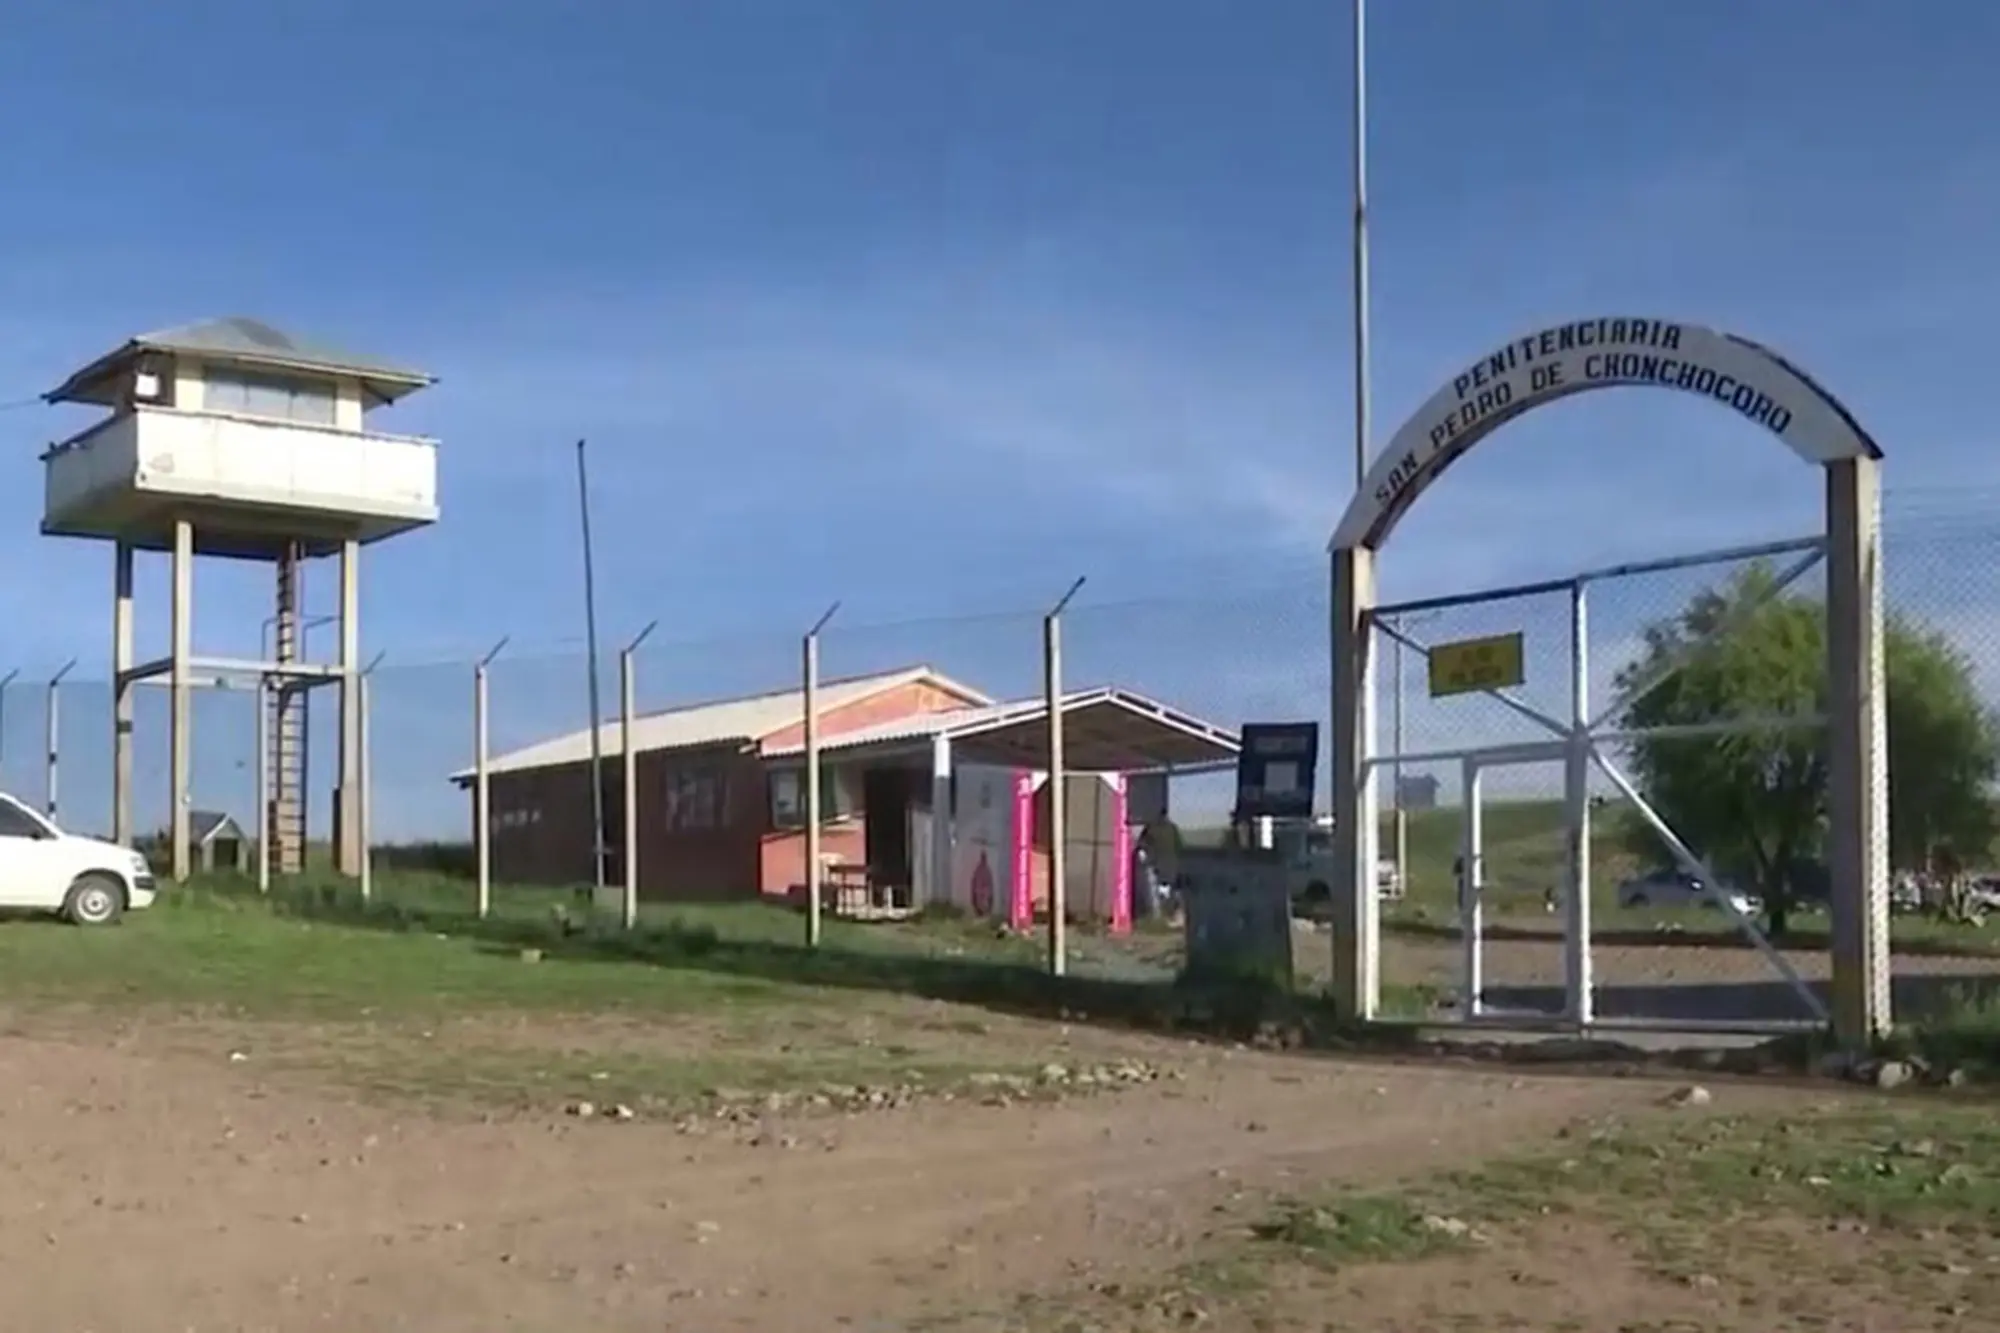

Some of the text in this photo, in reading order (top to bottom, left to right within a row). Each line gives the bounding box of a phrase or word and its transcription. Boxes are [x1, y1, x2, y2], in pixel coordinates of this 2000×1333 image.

[1454, 319, 1681, 398] PENITENCIARIA
[1375, 354, 1792, 503] SAN PEDRO DE CHONCHOCORO
